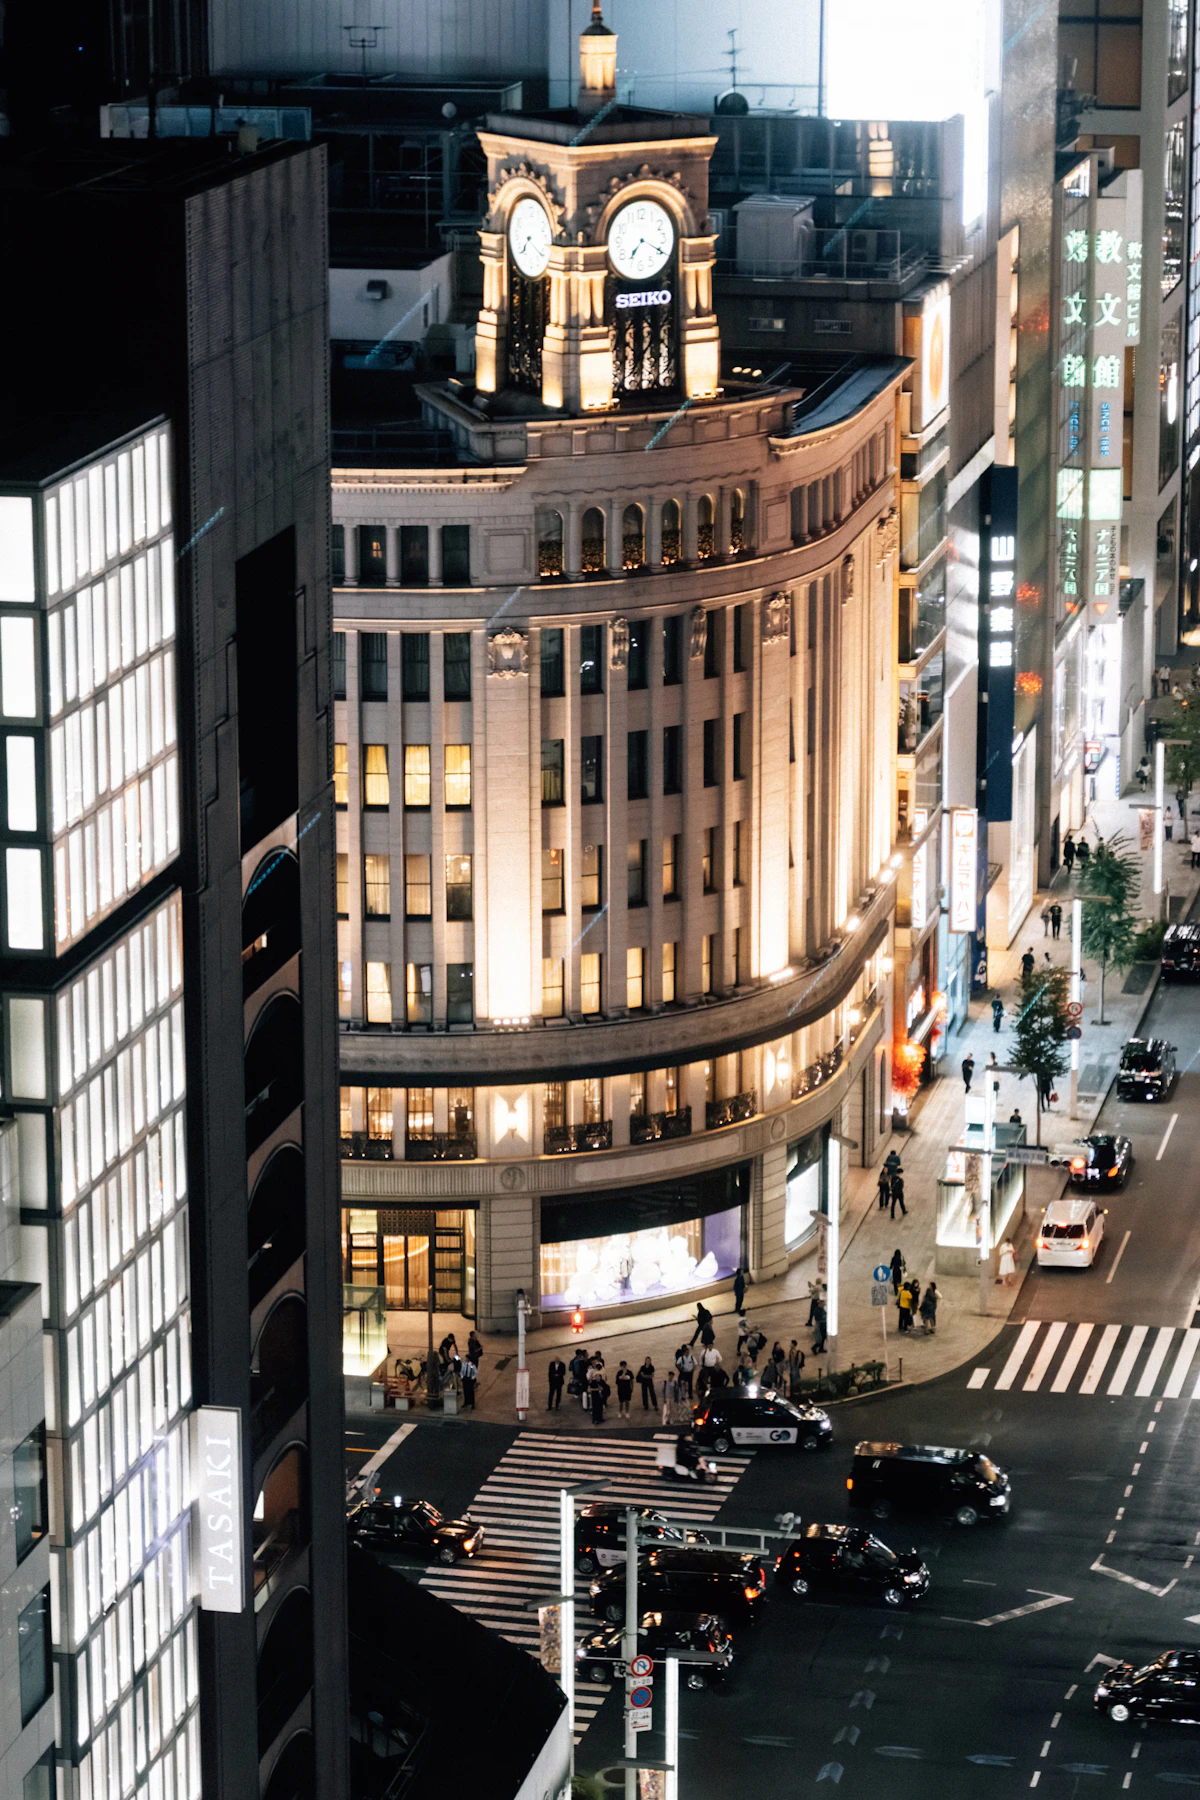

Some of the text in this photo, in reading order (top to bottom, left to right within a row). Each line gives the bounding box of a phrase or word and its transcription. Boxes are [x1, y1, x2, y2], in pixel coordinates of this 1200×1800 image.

[637, 207, 646, 220] 12
[656, 219, 664, 231] 2
[615, 236, 623, 248] 9
[660, 232, 667, 244] 3
[619, 248, 626, 261] 8
[637, 260, 644, 272] 6
[648, 256, 655, 268] 5
[1126, 241, 1142, 337] 教文館ビル
[615, 289, 672, 309] SEIKO
[1092, 229, 1122, 388] 教文館
[1101, 402, 1111, 432] SINCE
[1094, 529, 1110, 595] ナルニア国
[206, 1435, 234, 1590] TASAKI
